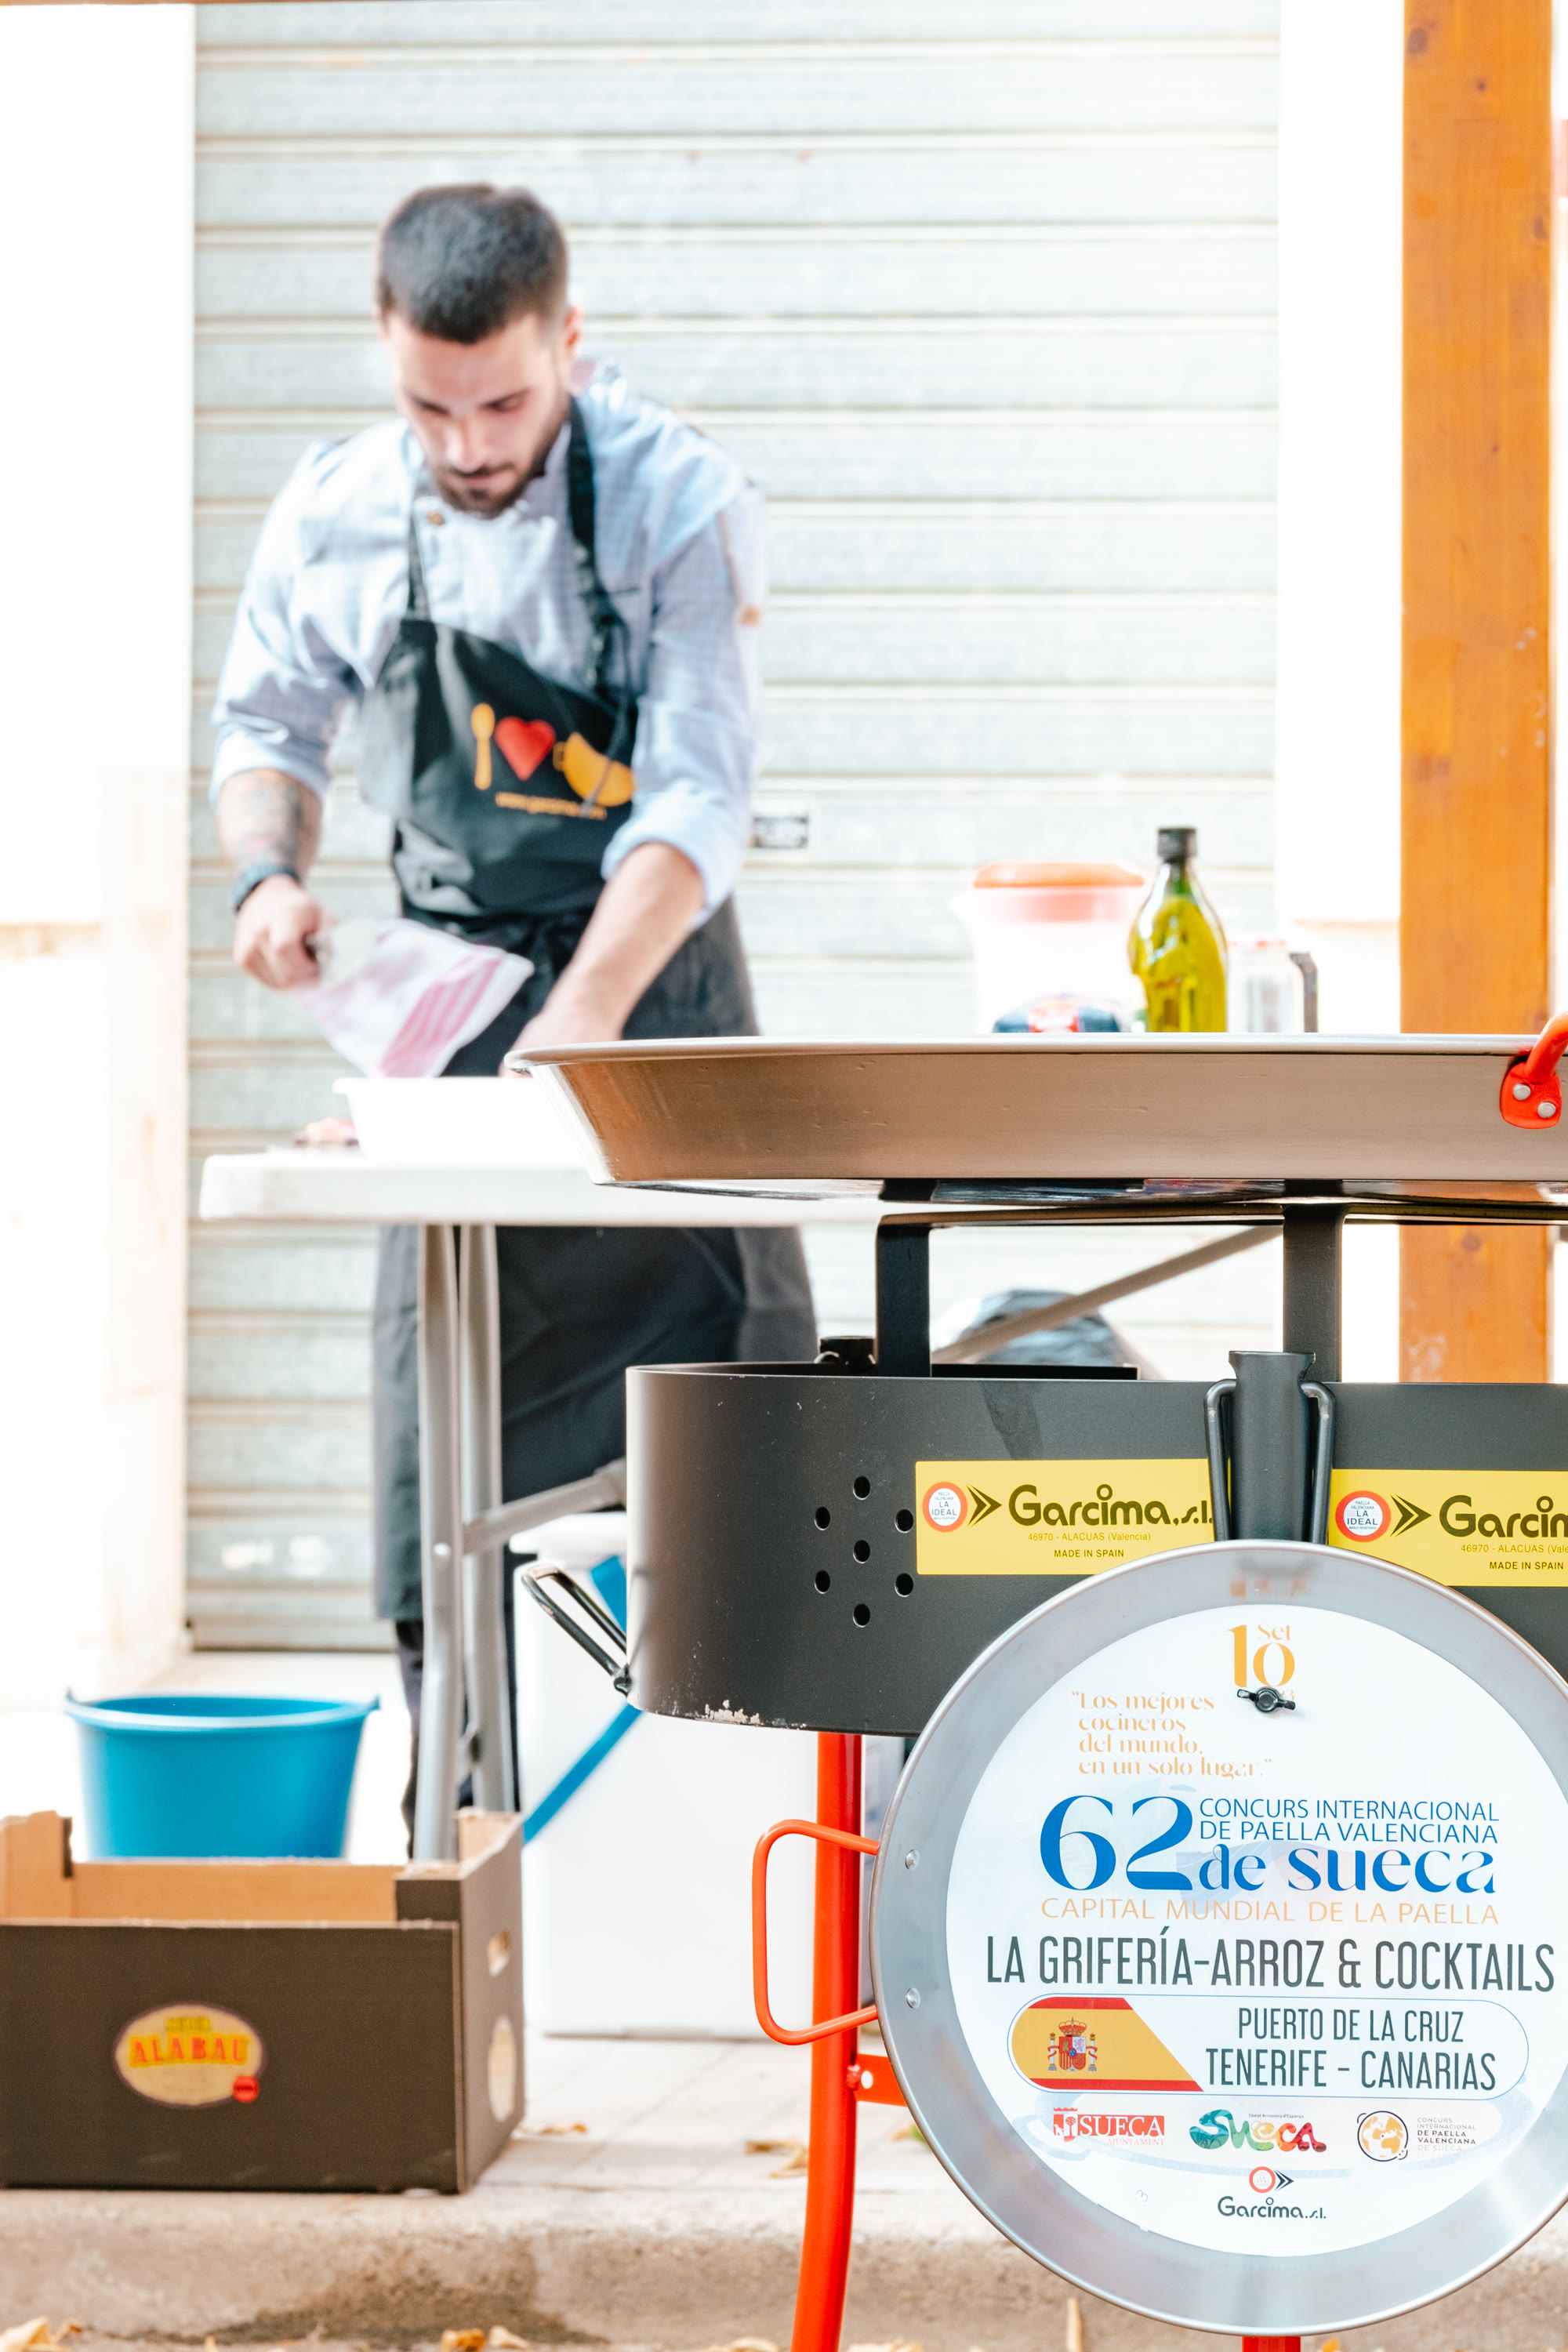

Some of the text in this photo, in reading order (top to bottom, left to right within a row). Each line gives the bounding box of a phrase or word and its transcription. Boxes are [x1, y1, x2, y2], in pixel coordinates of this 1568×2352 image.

[1028, 1533, 1054, 1541] 46970
[1062, 1533, 1105, 1541] ALACUAS
[1108, 1533, 1151, 1542] (Valencia)
[1497, 1544, 1544, 1553] ALACUAS
[1054, 1549, 1124, 1558] MADE IN SPAIN
[1489, 1561, 1564, 1570] MADE IN SPAIN
[1257, 1623, 1291, 1641] Set
[1226, 1624, 1296, 1688] 10
[1125, 1691, 1214, 1714] mejores
[1078, 1713, 1186, 1732] cocineros
[1079, 1733, 1203, 1755] del mundo,
[1079, 1760, 1105, 1774] en
[1112, 1761, 1141, 1774] un
[1147, 1756, 1193, 1776] solo
[1200, 1798, 1499, 1821] CONCURS INTERNACIONAL
[1040, 1795, 1193, 1890] 62
[1200, 1820, 1498, 1844] DE PAELLA VALENCIANA
[1199, 1843, 1497, 1894] de sueca
[1041, 1897, 1499, 1925] CAPITAL MUNDIAL DE LA PAELLA
[987, 1926, 1555, 1992] LA GRIFERÍA-ARROZ & COCKTAILS
[1238, 2007, 1464, 2043] PUERTO DE LA CRUZ
[1206, 2048, 1327, 2087] TENERIFE
[1361, 2049, 1496, 2091] CANARIAS
[1080, 2115, 1164, 2137] SUECA
[1107, 2138, 1165, 2147] AJUNTAMENT
